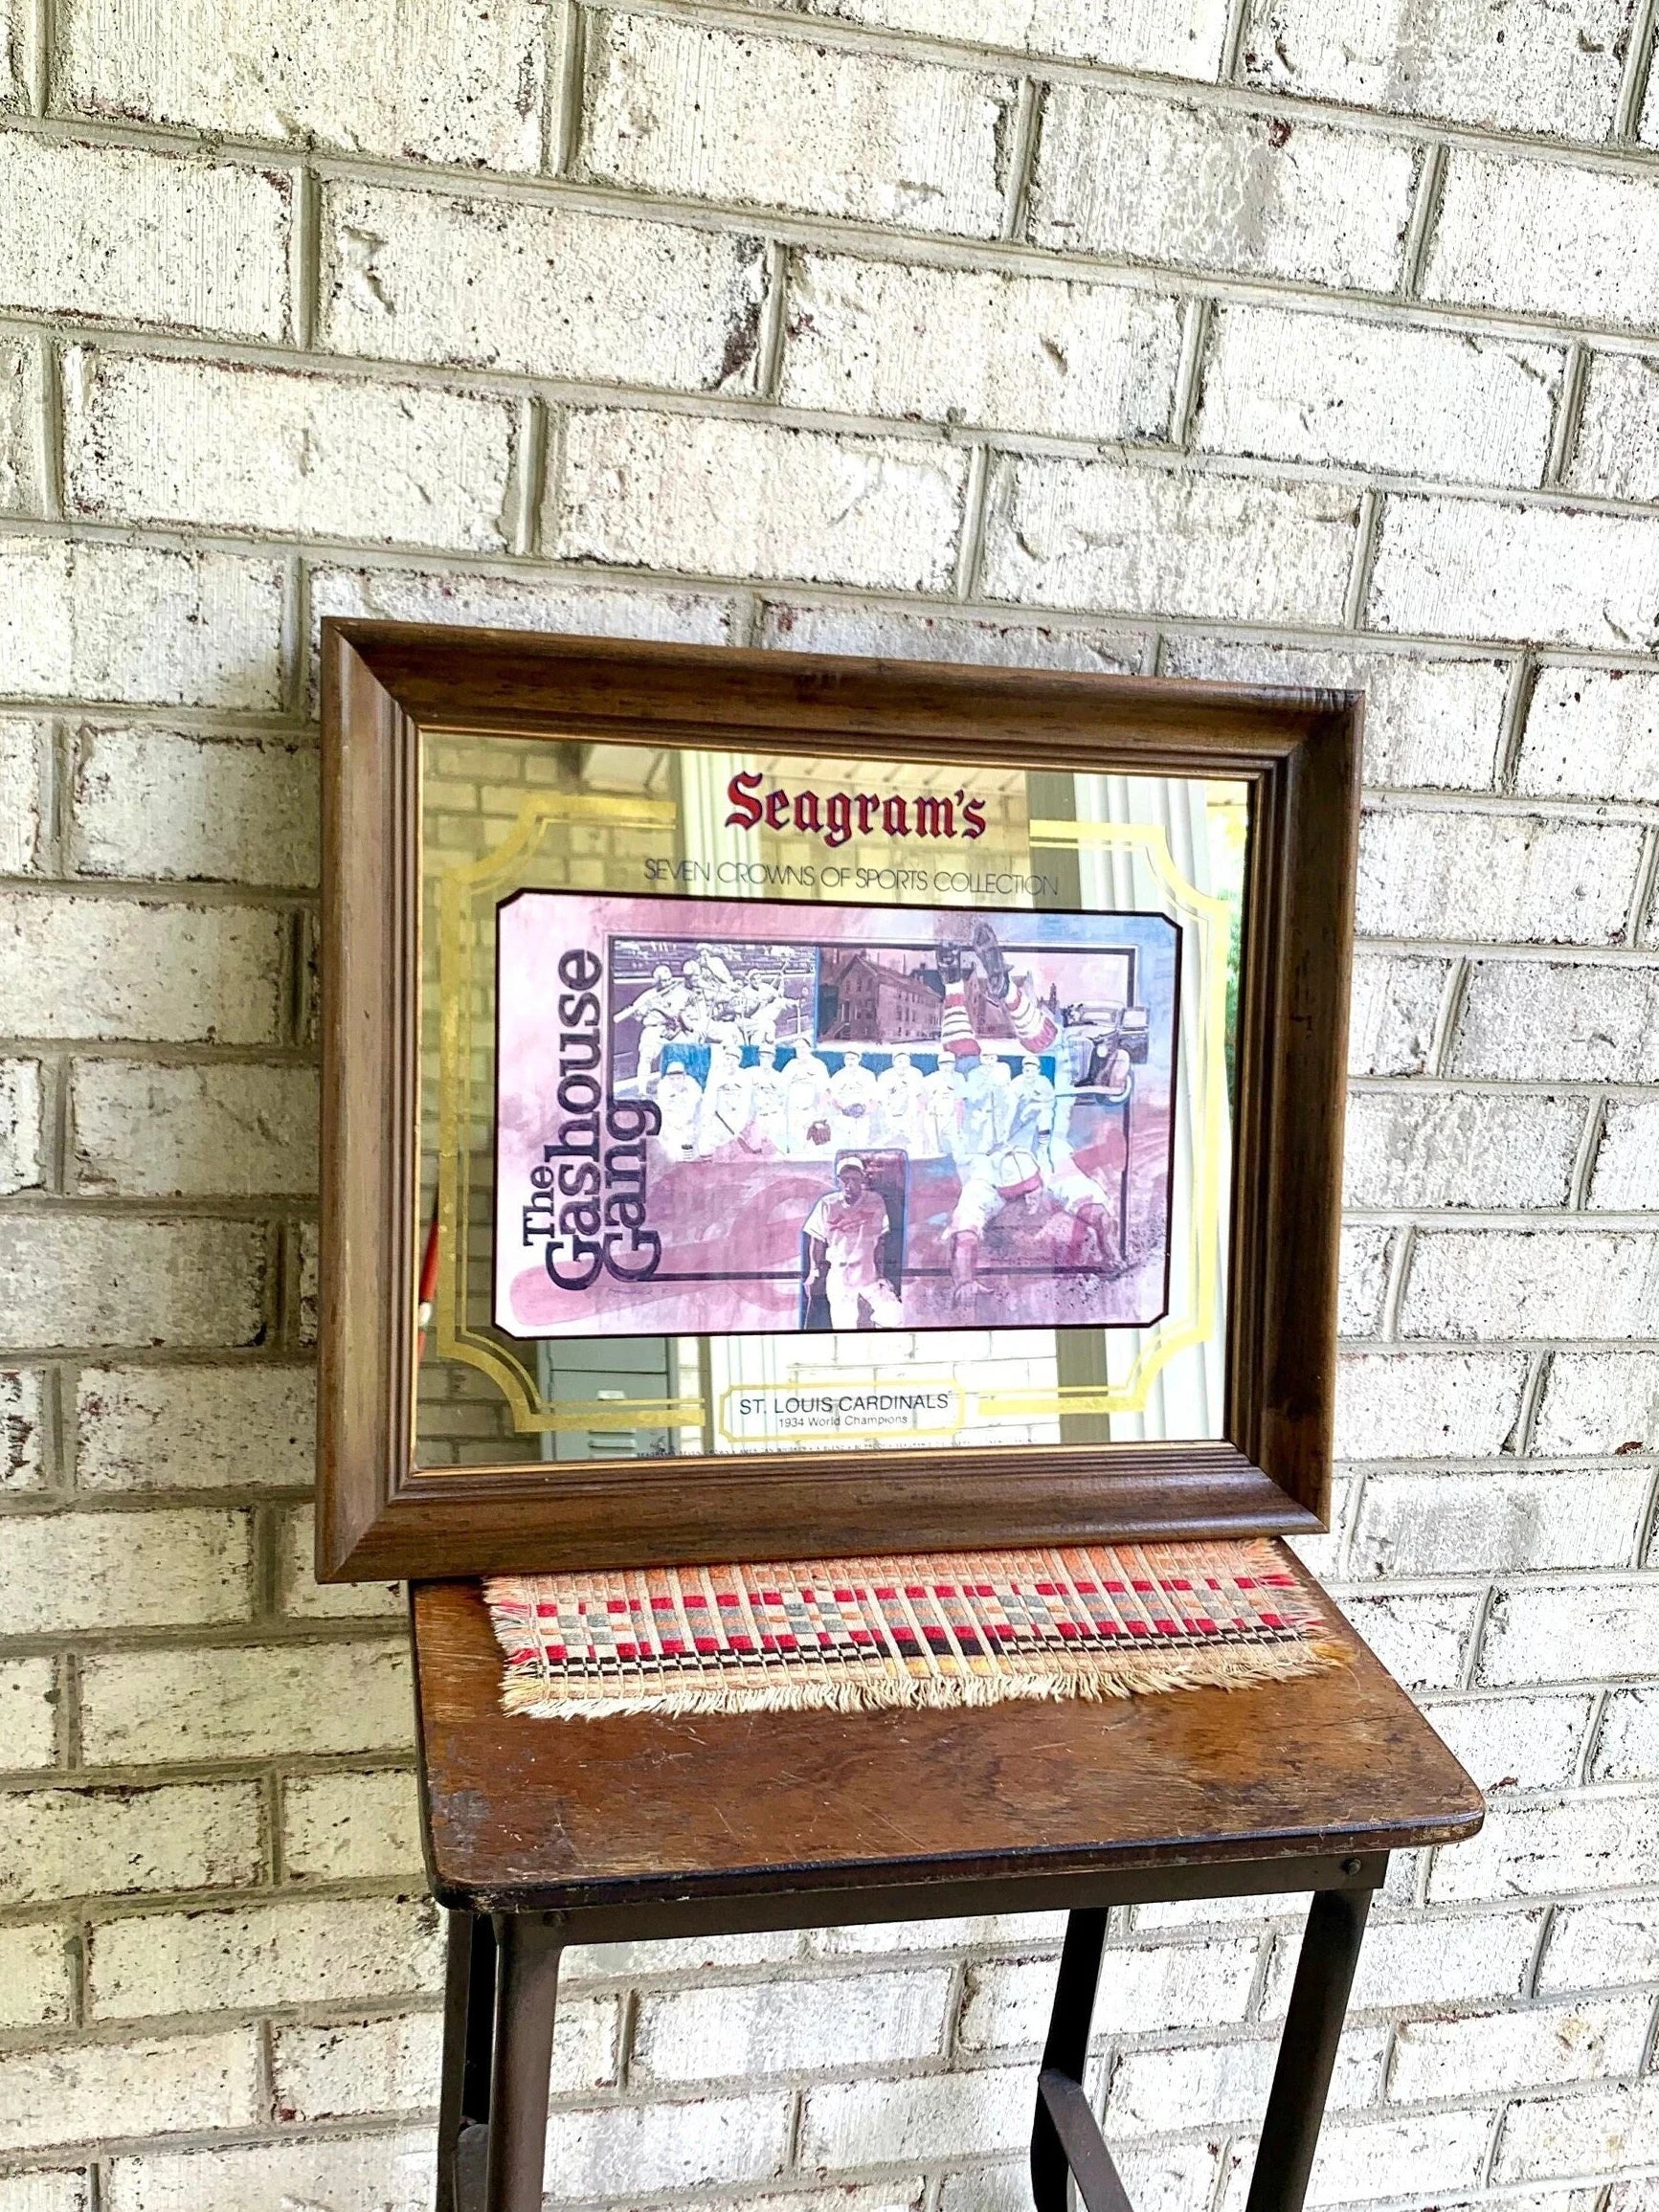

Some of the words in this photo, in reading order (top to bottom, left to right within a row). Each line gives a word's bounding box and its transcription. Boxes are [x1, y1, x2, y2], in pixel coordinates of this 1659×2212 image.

[725, 771, 987, 848] Seagram's
[643, 858, 710, 883] SEVEN
[717, 860, 816, 888] CROWNS
[820, 865, 850, 888] OF
[855, 867, 928, 892] SPORTS
[933, 871, 1059, 897] COLLECTION
[544, 949, 603, 1291] Gashouse
[523, 1165, 555, 1247] The
[603, 1099, 661, 1282] Gang
[739, 1398, 767, 1415] ST.
[774, 1396, 833, 1414] LOUIS
[839, 1394, 949, 1412] CARDINALS
[778, 1418, 805, 1428] 1934
[808, 1417, 841, 1427] World
[844, 1415, 908, 1428] Champions
